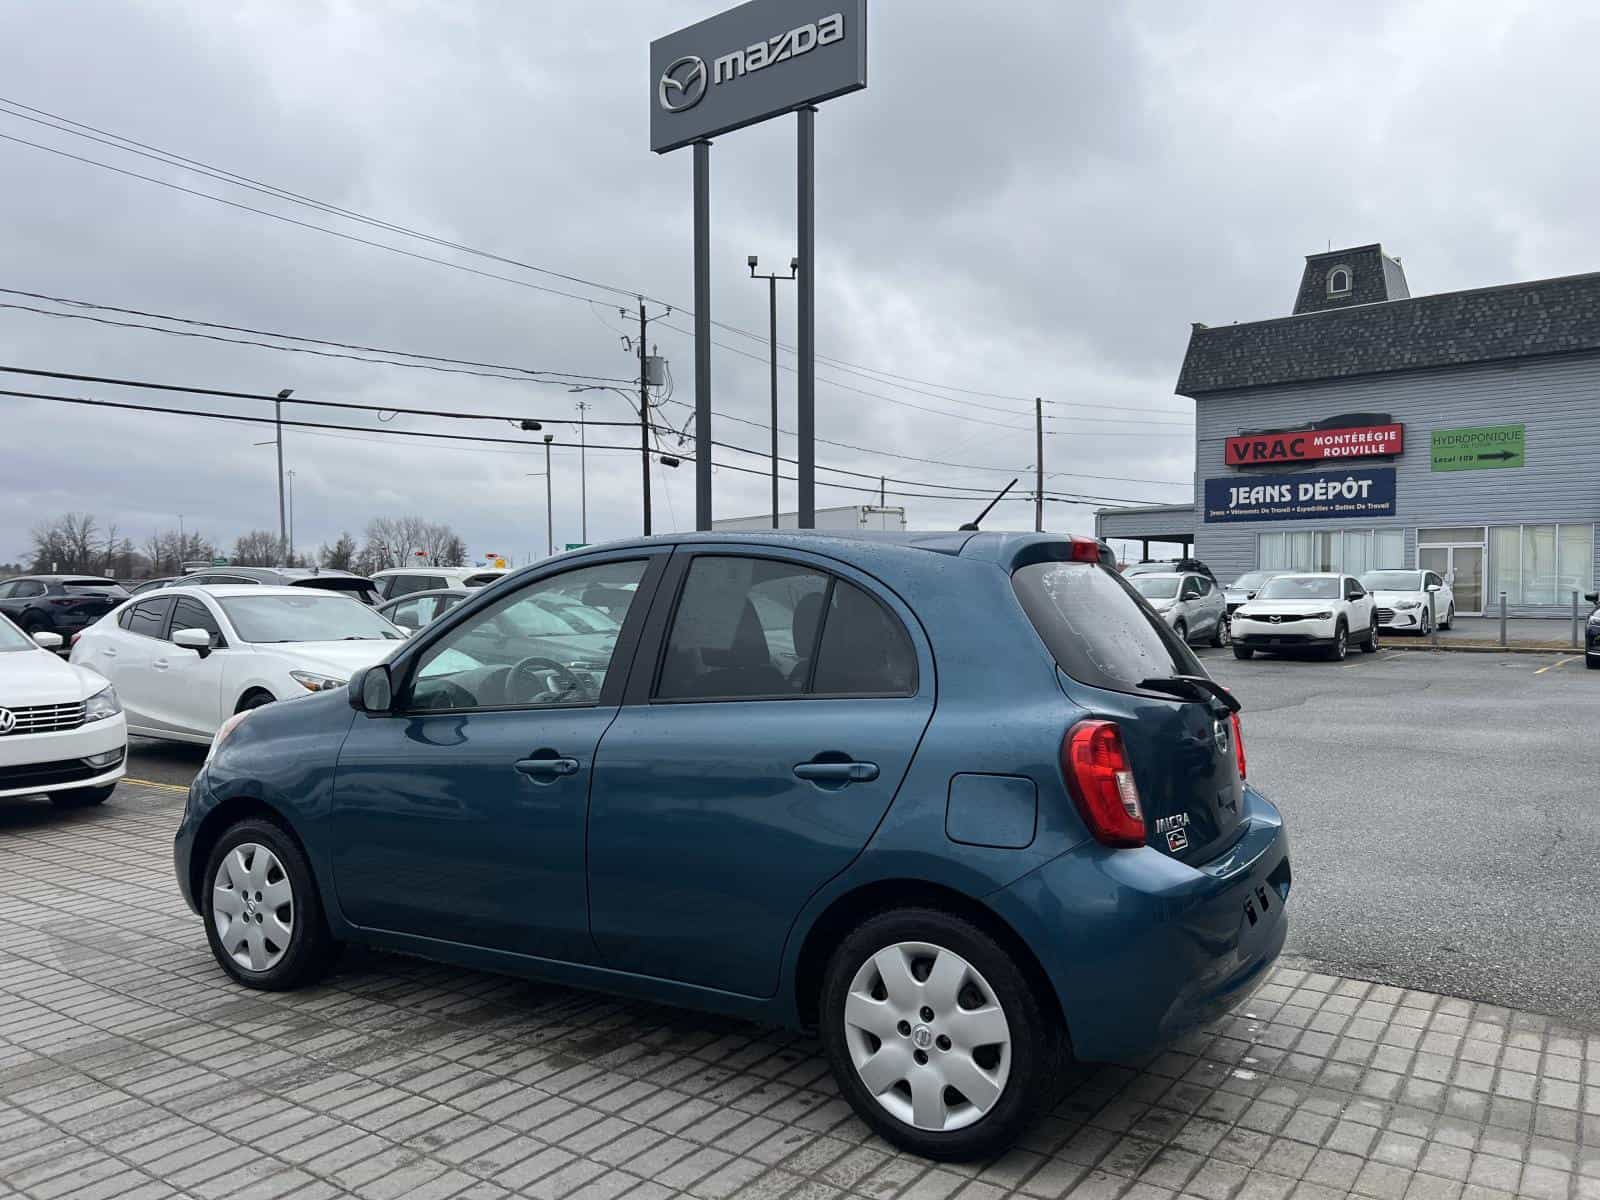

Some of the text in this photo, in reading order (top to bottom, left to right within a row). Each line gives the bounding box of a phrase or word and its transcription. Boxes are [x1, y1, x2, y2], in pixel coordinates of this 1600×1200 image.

[1314, 431, 1397, 446] MONTÉRÉGIE
[1433, 430, 1521, 446] HYDROPONIQUE
[1233, 438, 1305, 461] VRAC
[1323, 443, 1386, 457] ROUVILLE
[1229, 477, 1373, 508] JEANS DÉPÔT
